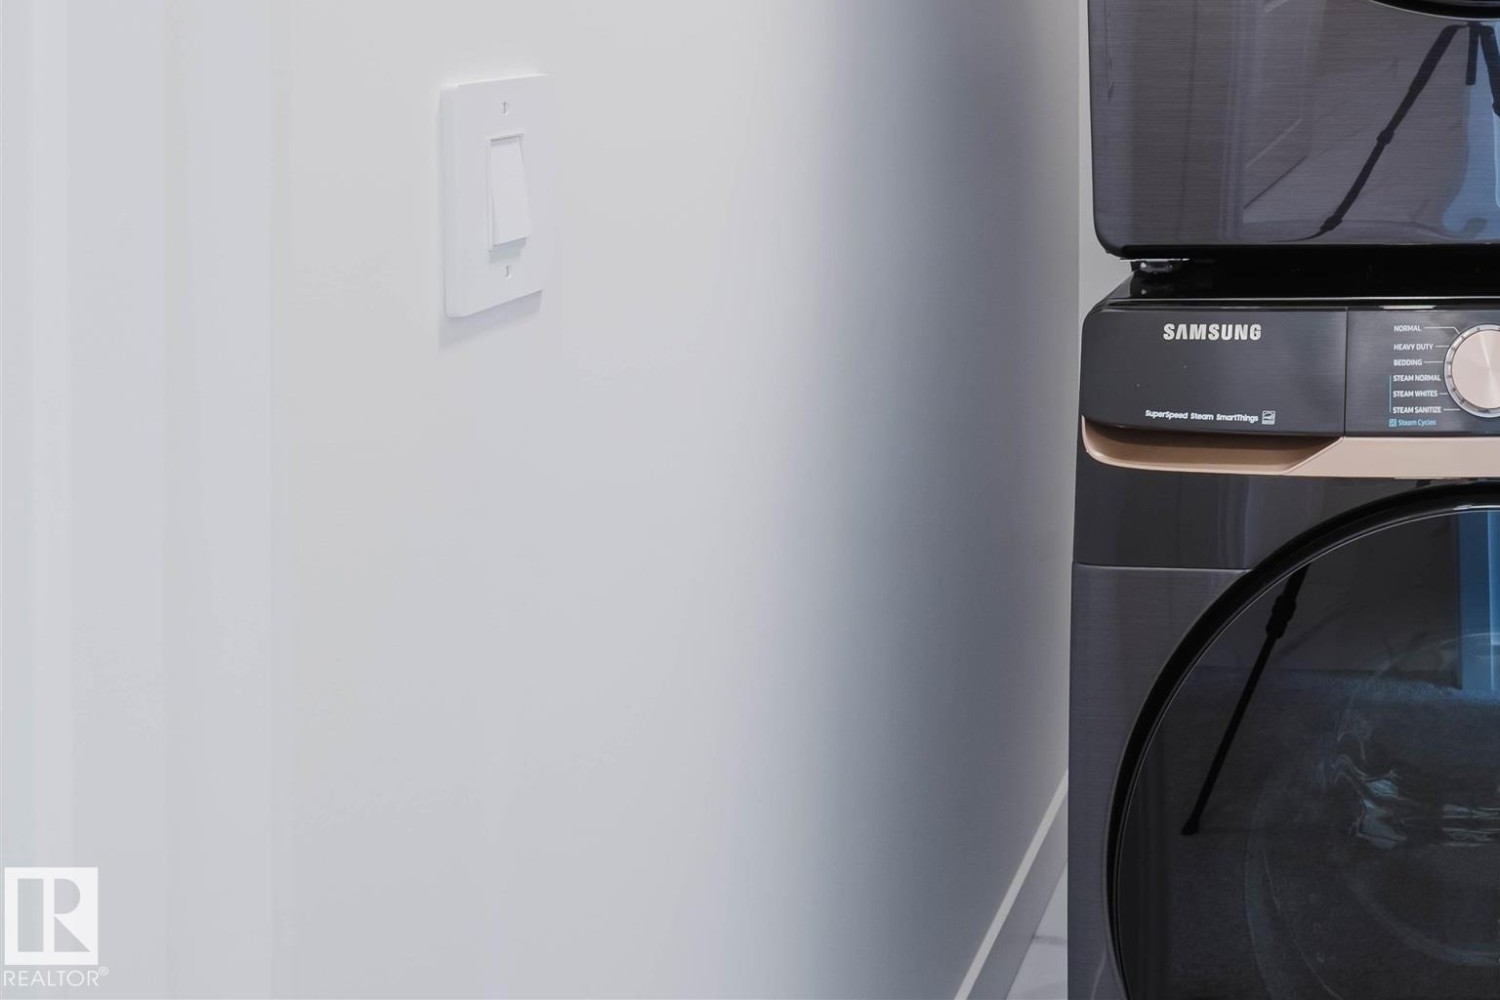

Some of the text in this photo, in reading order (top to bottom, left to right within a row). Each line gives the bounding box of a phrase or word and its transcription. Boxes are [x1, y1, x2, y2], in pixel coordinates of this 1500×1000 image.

[1163, 323, 1262, 341] SAMSUNG
[1393, 324, 1422, 332] NORMAL
[1393, 343, 1434, 351] HEAVY DUTY
[1393, 358, 1423, 366] BEDDING
[1392, 374, 1442, 382] STEAM NORMAL
[1392, 390, 1438, 398] STEAM WHITES
[1392, 405, 1442, 414] STEAM SANITIZE
[1145, 409, 1259, 423] SuperSpeed Steam SmartThings
